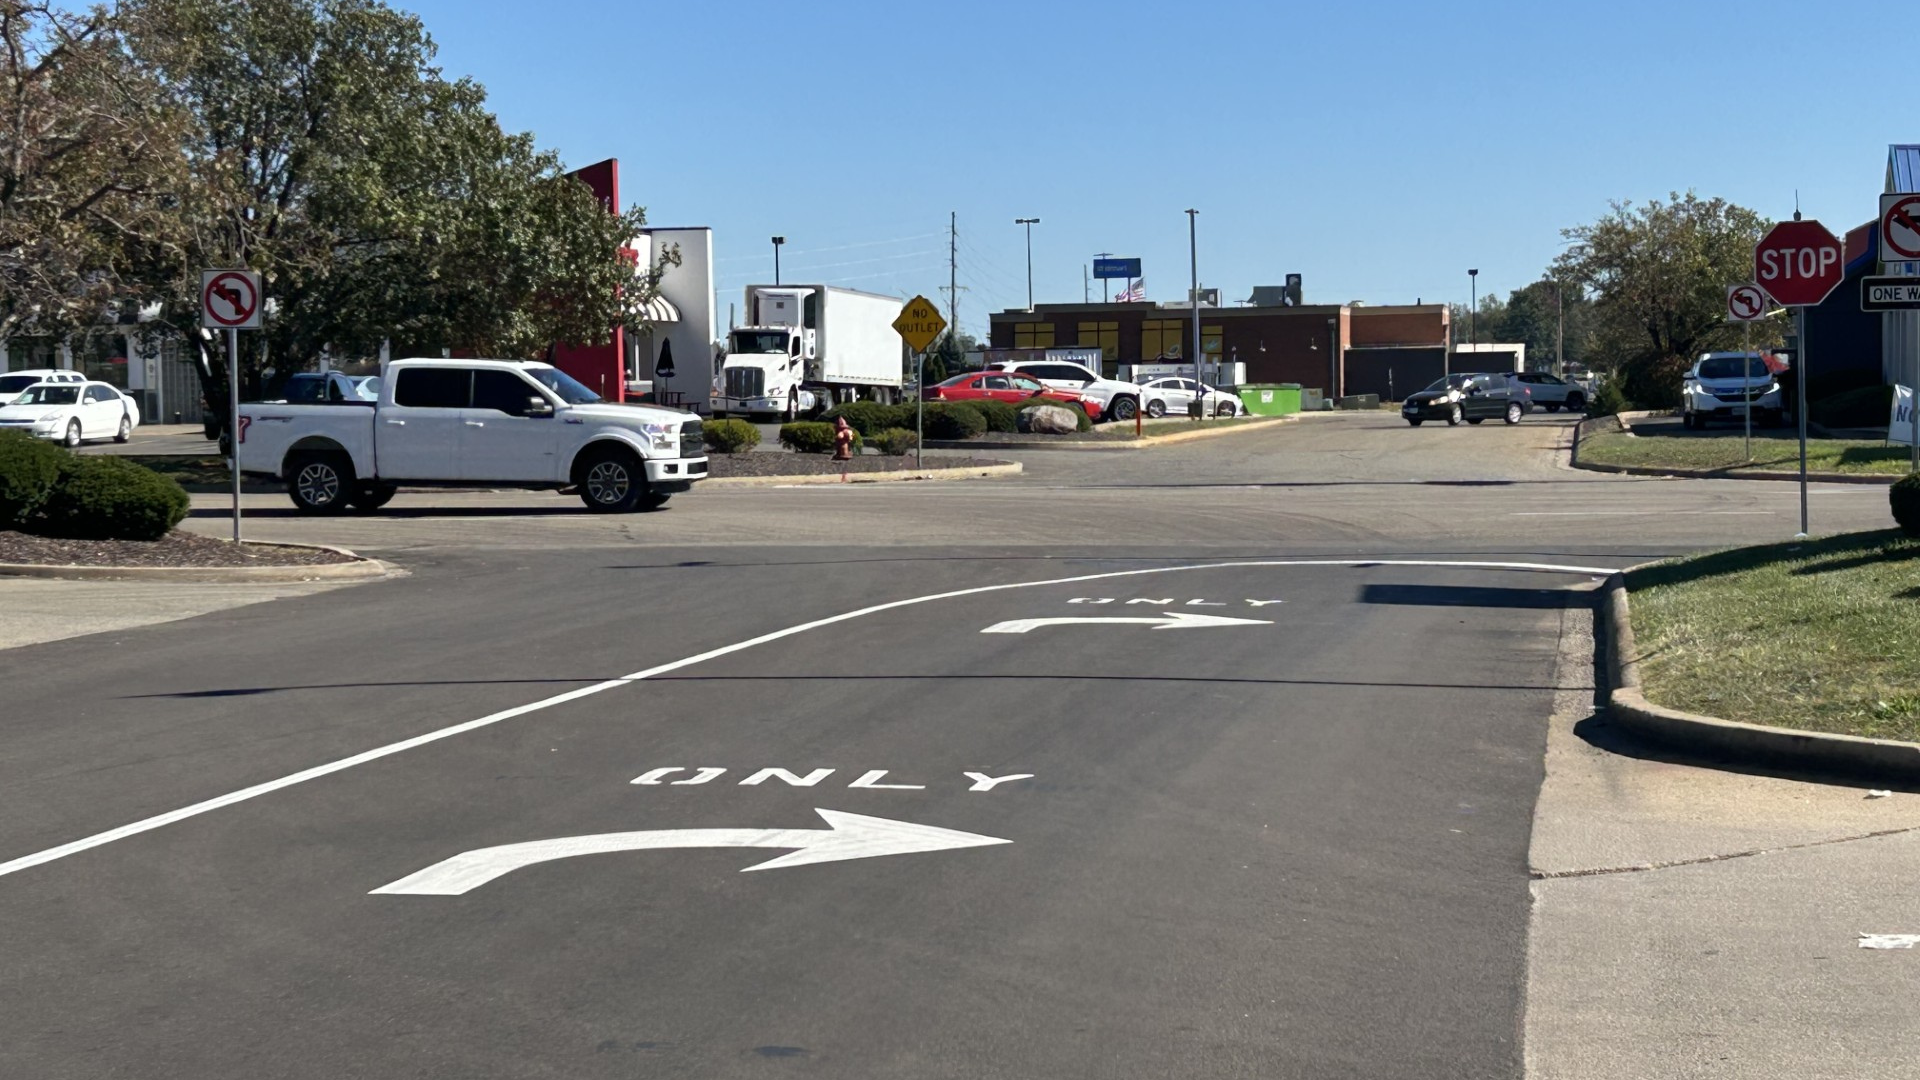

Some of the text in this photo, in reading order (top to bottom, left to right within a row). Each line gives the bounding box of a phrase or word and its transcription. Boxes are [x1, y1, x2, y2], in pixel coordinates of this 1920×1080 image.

[1761, 247, 1837, 280] STOP
[1873, 288, 1903, 301] ONE
[912, 308, 928, 319] NO
[899, 322, 939, 333] OUTLET
[1066, 597, 1284, 607] ONLY
[629, 766, 1035, 792] ONLY
